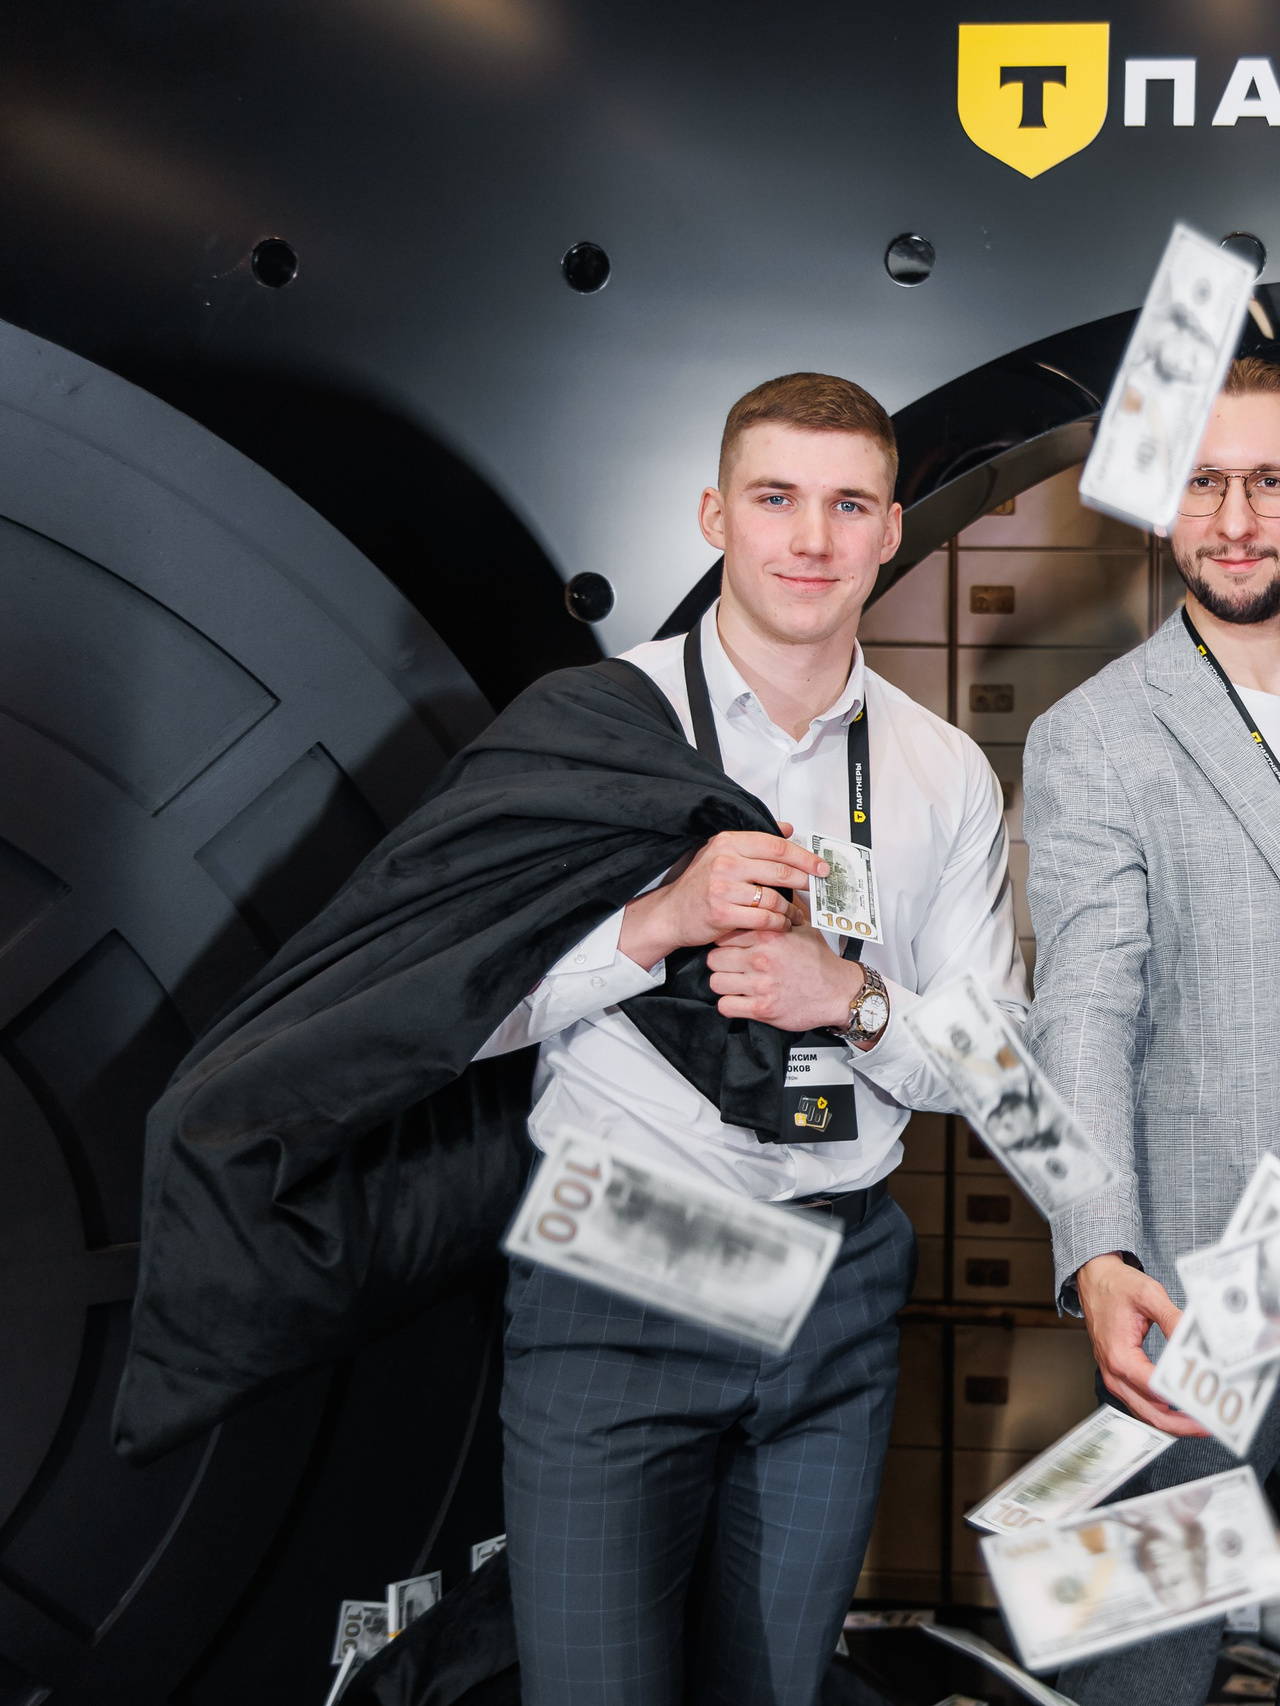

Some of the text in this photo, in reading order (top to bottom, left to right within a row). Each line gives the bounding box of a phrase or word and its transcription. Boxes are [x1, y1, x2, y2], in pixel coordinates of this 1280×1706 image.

[822, 913, 872, 936] 100
[538, 1155, 601, 1244] 100
[1178, 1357, 1244, 1427] 100
